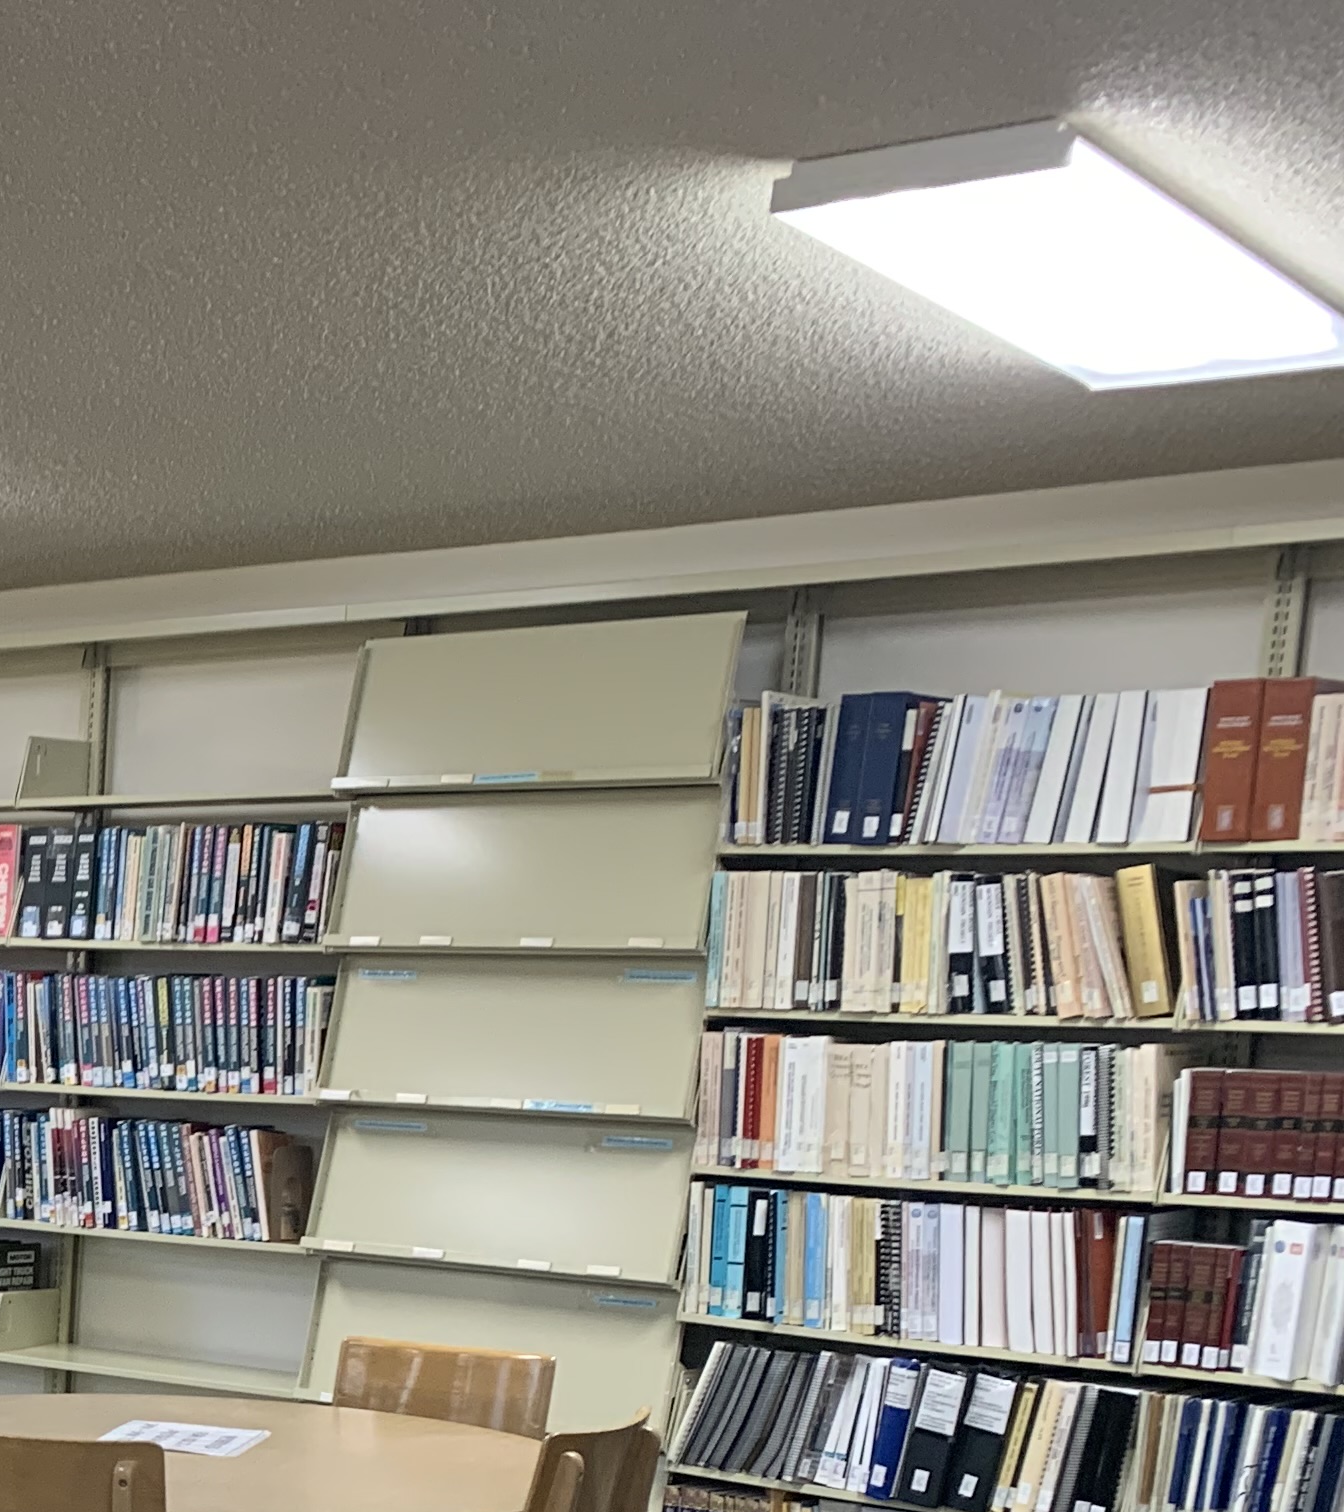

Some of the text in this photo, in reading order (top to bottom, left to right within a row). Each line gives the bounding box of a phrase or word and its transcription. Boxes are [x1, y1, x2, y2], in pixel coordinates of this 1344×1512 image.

[63, 976, 71, 1020] CHILTON
[80, 977, 88, 1024] CHILTON
[89, 976, 98, 1023] CHILTON
[99, 977, 107, 1023] CHILTON
[118, 977, 128, 1023] CHILTON
[174, 978, 182, 1025] CHILTON
[184, 977, 192, 1024] CHILTON
[203, 978, 211, 1025] CHILTON
[215, 979, 224, 1025] CHILTON
[240, 978, 248, 1025] CHILTON
[3, 1113, 11, 1156] CHILTON
[80, 1119, 88, 1163] CHILTON
[121, 1124, 131, 1168] CHILTON
[138, 1123, 150, 1169] CHILTON
[148, 1124, 160, 1169] CHILTON
[160, 1123, 171, 1169] CHILTON
[172, 1126, 184, 1173] CHILTON
[228, 1128, 240, 1174] CHILTON
[240, 1130, 252, 1177] CHILTON
[12, 1276, 33, 1285] REPAIR
[14, 1267, 33, 1275] TRUCK
